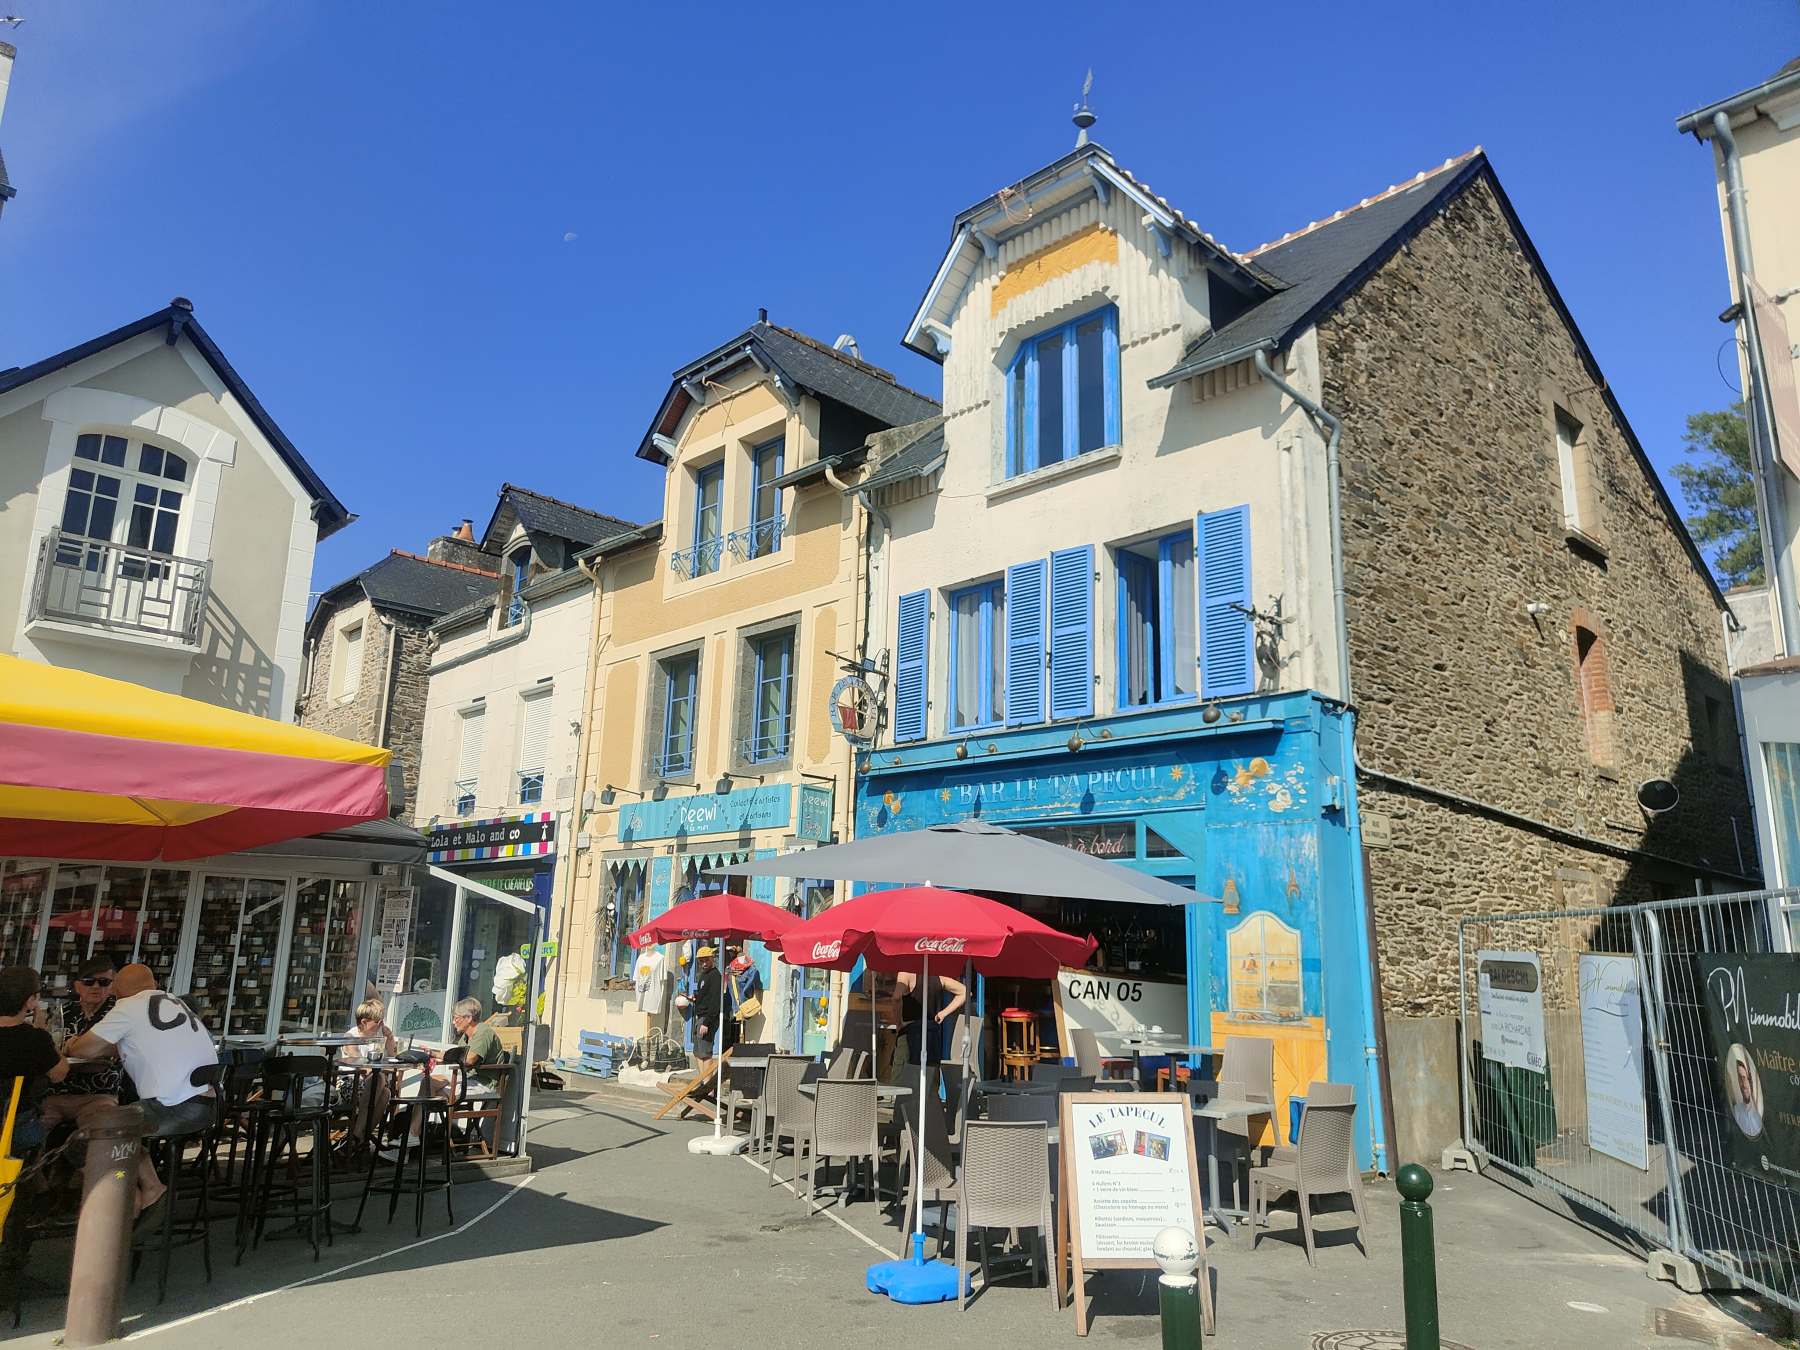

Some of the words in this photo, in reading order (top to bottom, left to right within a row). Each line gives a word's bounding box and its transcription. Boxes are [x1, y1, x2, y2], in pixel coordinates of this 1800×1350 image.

[959, 780, 1004, 805] BAR
[1015, 777, 1039, 802] LE
[680, 803, 717, 824] Deewi
[430, 835, 449, 848] Lola
[452, 834, 462, 846] et
[465, 830, 485, 845] Malo
[489, 828, 505, 842] and
[509, 828, 521, 839] co
[1090, 832, 1125, 855] bord
[914, 937, 967, 953] Coca-Cola
[1068, 979, 1110, 1001] CAN
[1116, 982, 1143, 1002] 05
[1756, 1047, 1796, 1073] Maître
[1088, 1112, 1106, 1129] LE
[1107, 1106, 1166, 1129] TAPECUL
